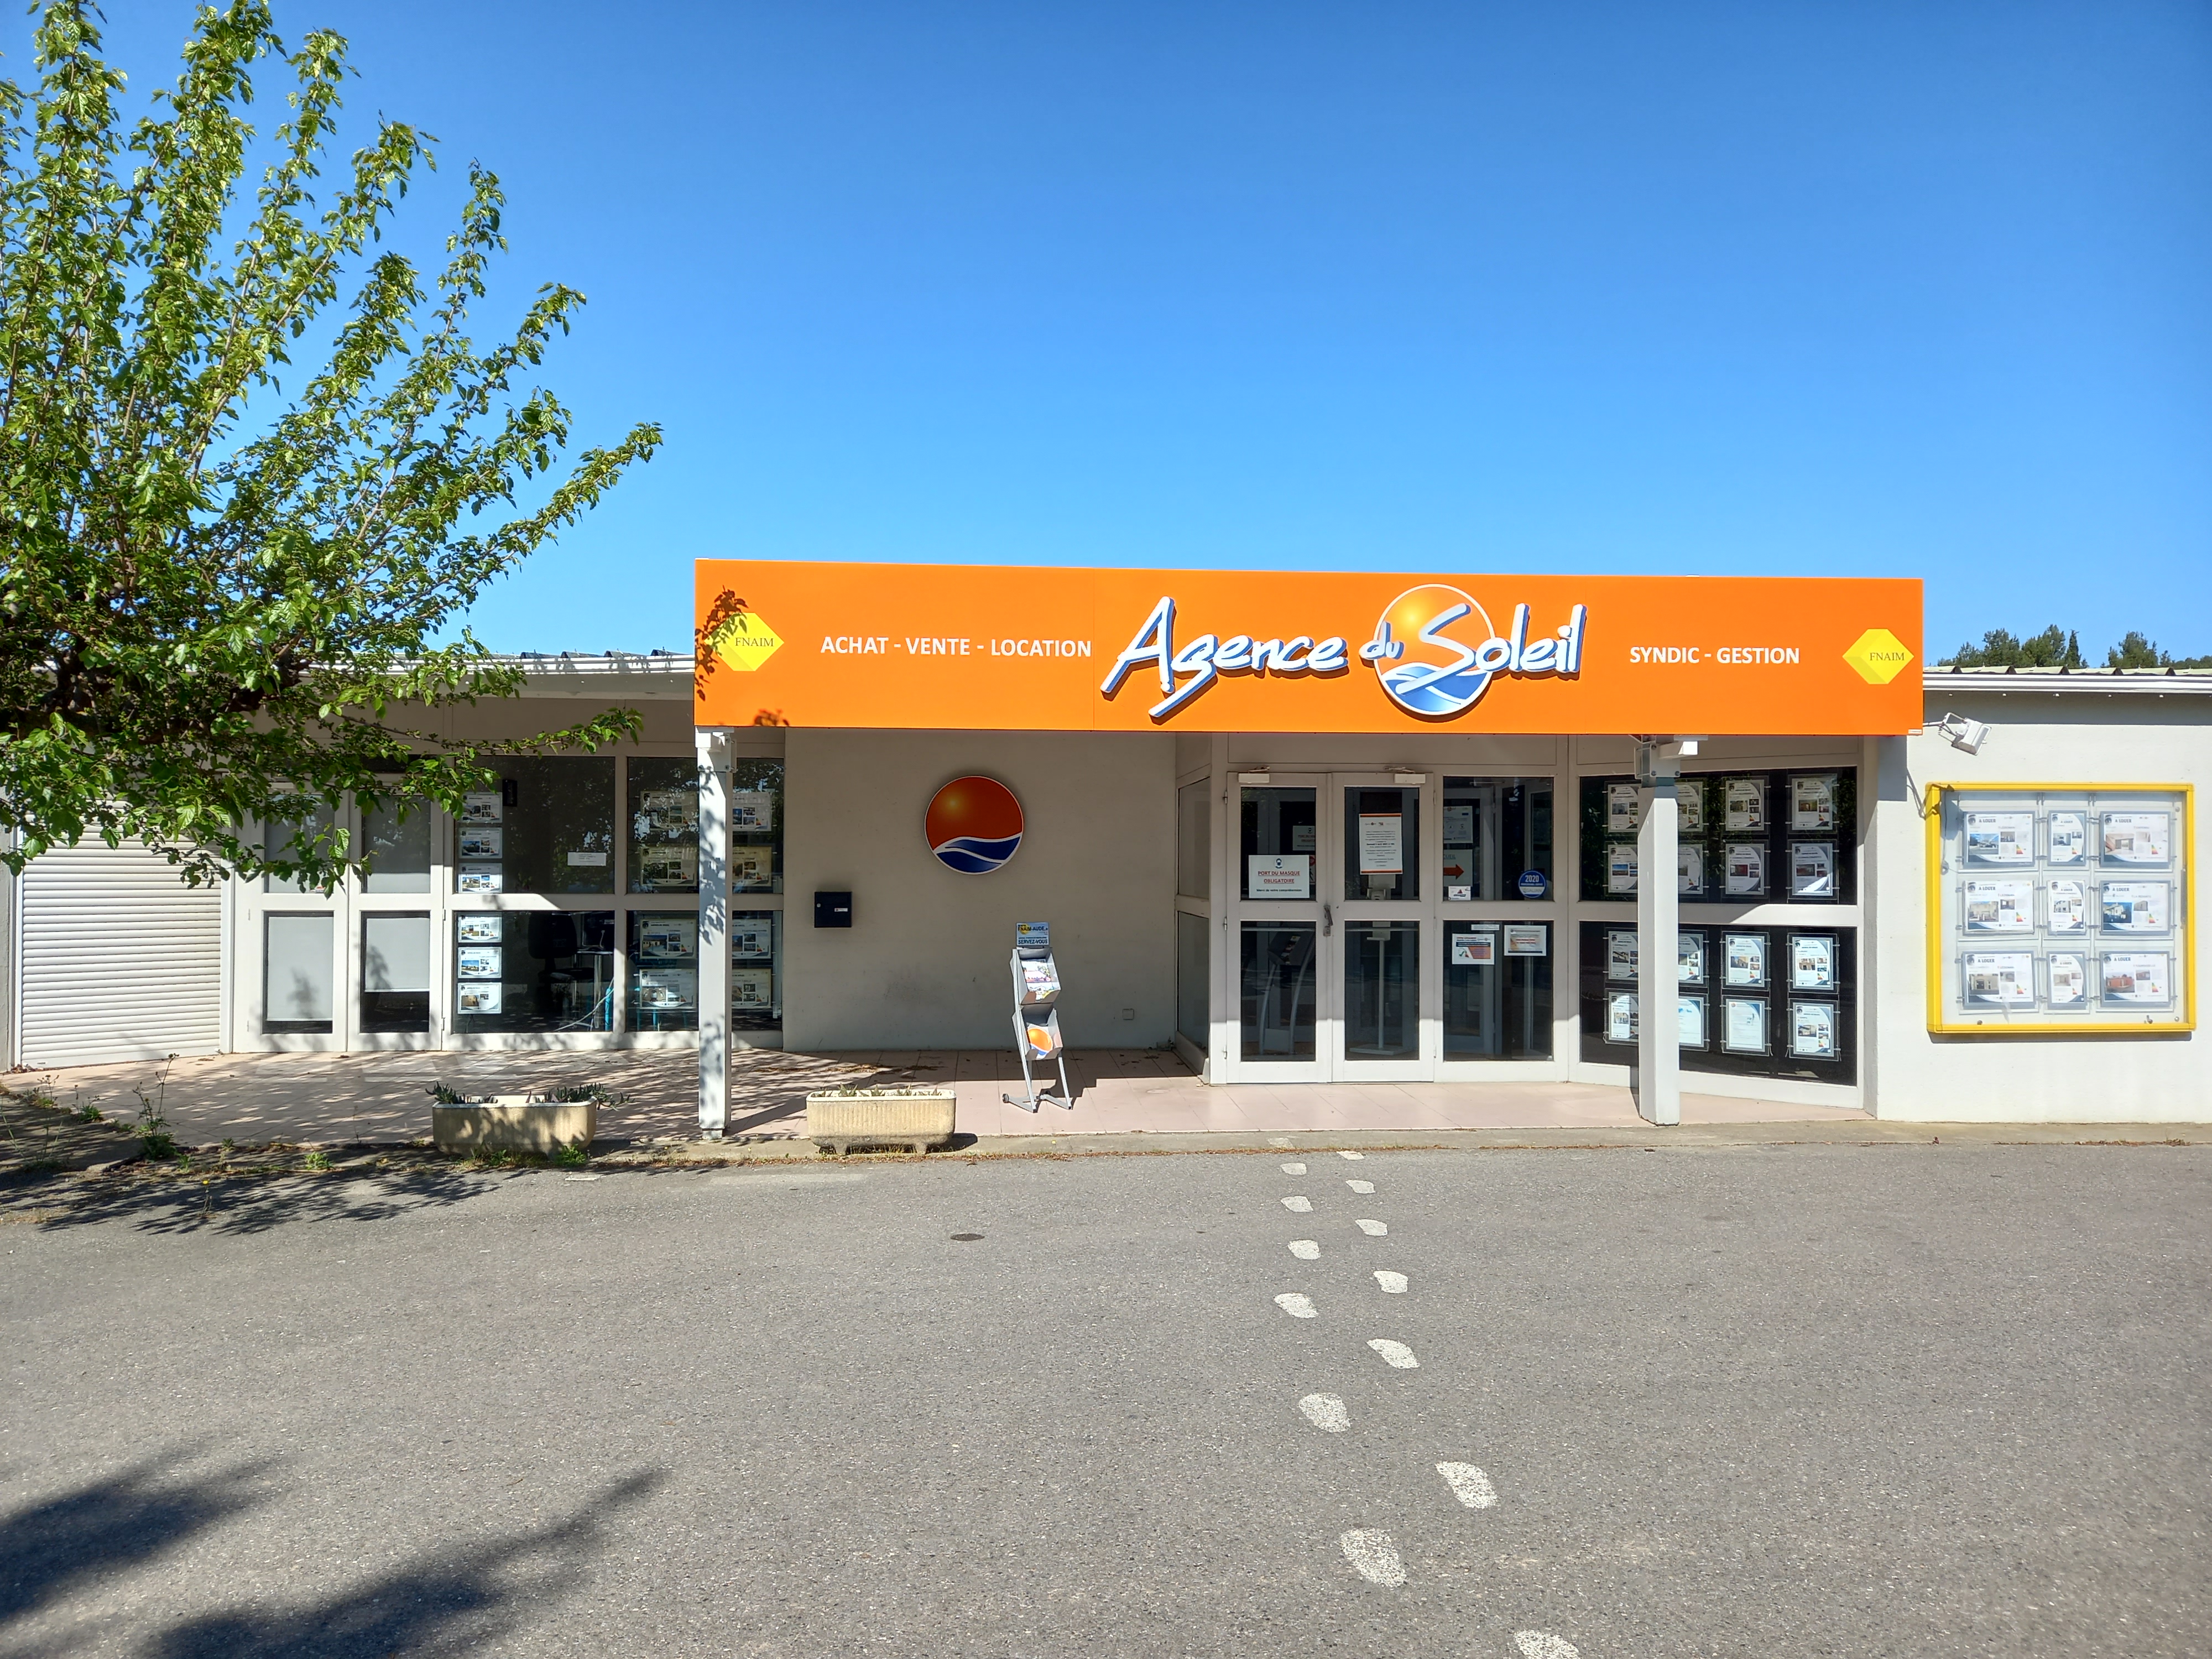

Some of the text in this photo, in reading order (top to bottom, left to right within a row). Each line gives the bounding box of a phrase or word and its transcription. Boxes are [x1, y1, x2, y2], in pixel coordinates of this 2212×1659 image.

[734, 636, 774, 648] FNAIM
[820, 635, 889, 655] ACHAT
[905, 638, 971, 656] VENTE
[991, 638, 1092, 658] LOCATION
[1100, 595, 1588, 719] Agence du Soleil
[1630, 646, 1700, 664] SYNDIC
[1717, 646, 1799, 664] GESTION
[1869, 652, 1905, 661] FNAIM
